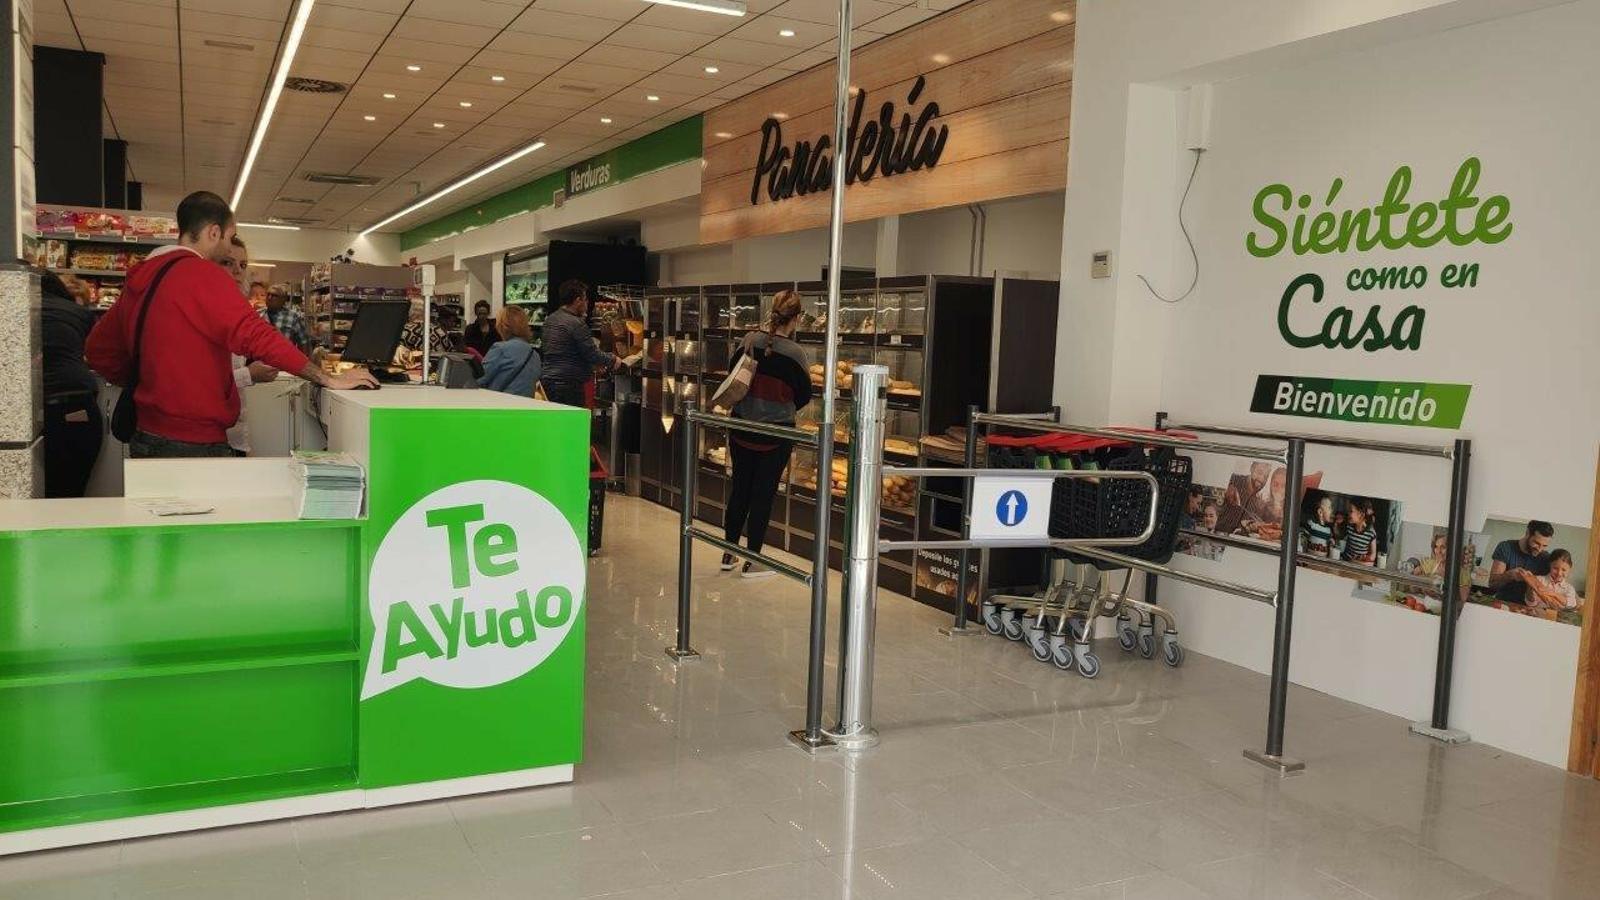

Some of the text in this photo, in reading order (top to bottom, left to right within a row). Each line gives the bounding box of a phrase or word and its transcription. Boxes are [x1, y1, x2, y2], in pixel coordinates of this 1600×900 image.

[570, 163, 610, 193] Verduras
[1246, 157, 1513, 257] Siéntete
[1277, 273, 1426, 352] Casa
[1346, 263, 1479, 290] como en
[1273, 381, 1437, 421] Bienvenido
[426, 503, 519, 589] Te
[381, 585, 573, 674] Ayudo
